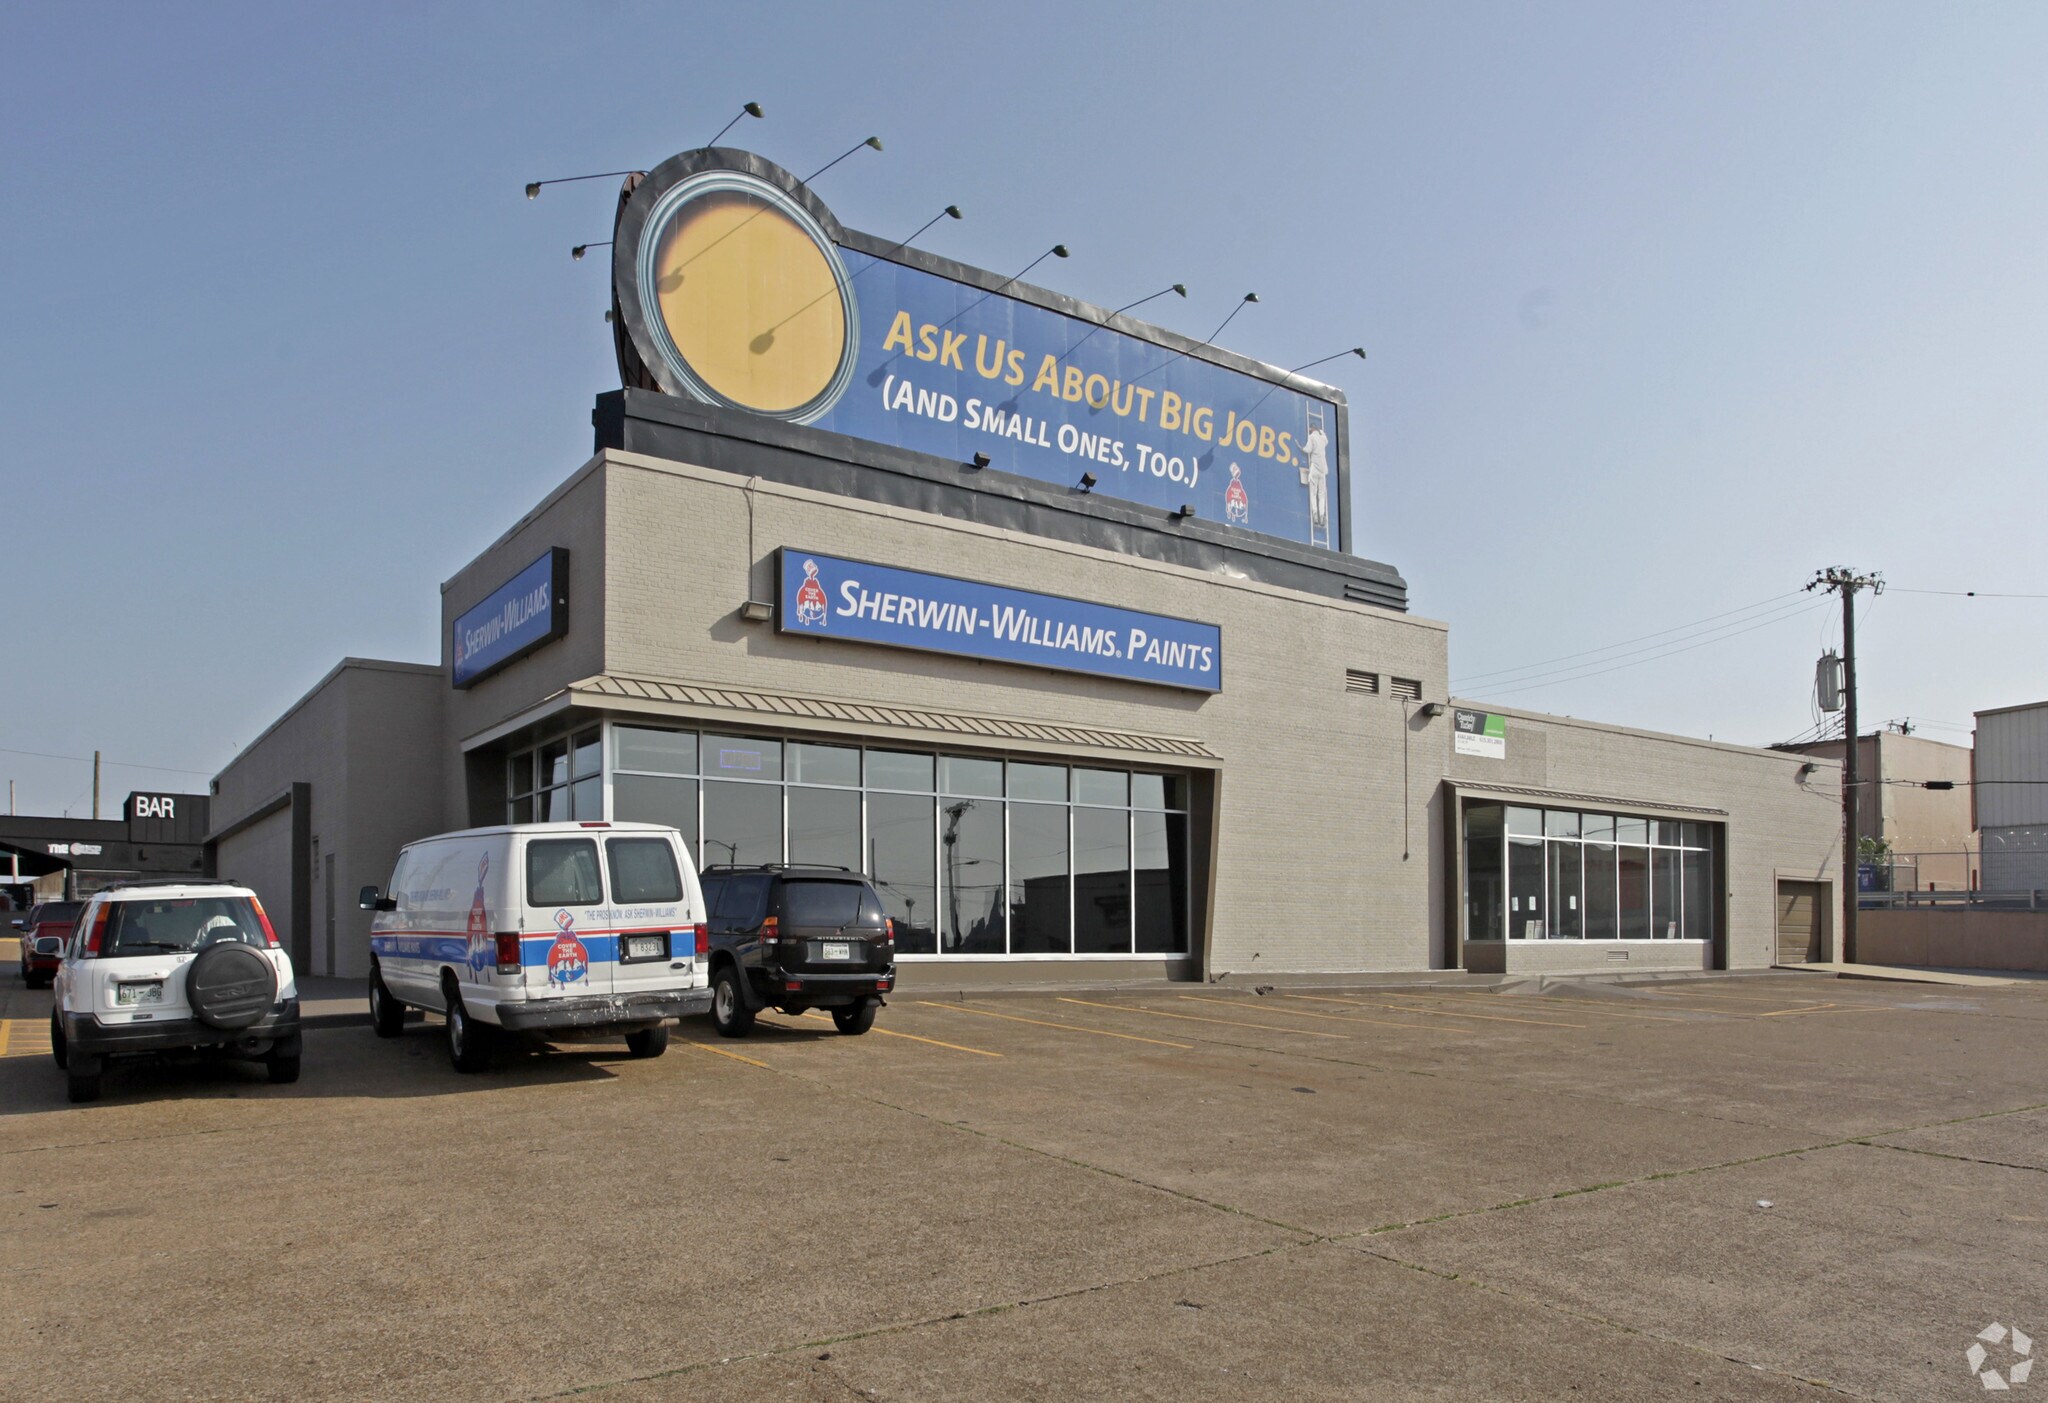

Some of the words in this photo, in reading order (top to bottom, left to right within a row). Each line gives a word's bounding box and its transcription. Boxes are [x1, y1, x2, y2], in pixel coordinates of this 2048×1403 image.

[883, 310, 968, 371] ASK
[975, 334, 1025, 386] US
[1032, 353, 1155, 423] ABOUT
[1159, 388, 1214, 441] BIG
[1218, 410, 1299, 467] JOBS.
[882, 374, 958, 423] (AND
[963, 398, 1051, 449] SMALL
[1057, 423, 1130, 473] ONES,
[1136, 443, 1199, 489] TOO.)
[465, 582, 549, 660] SHERWIN-WILLIAMS
[1127, 628, 1213, 673] PAINTS
[136, 796, 174, 818] BAR
